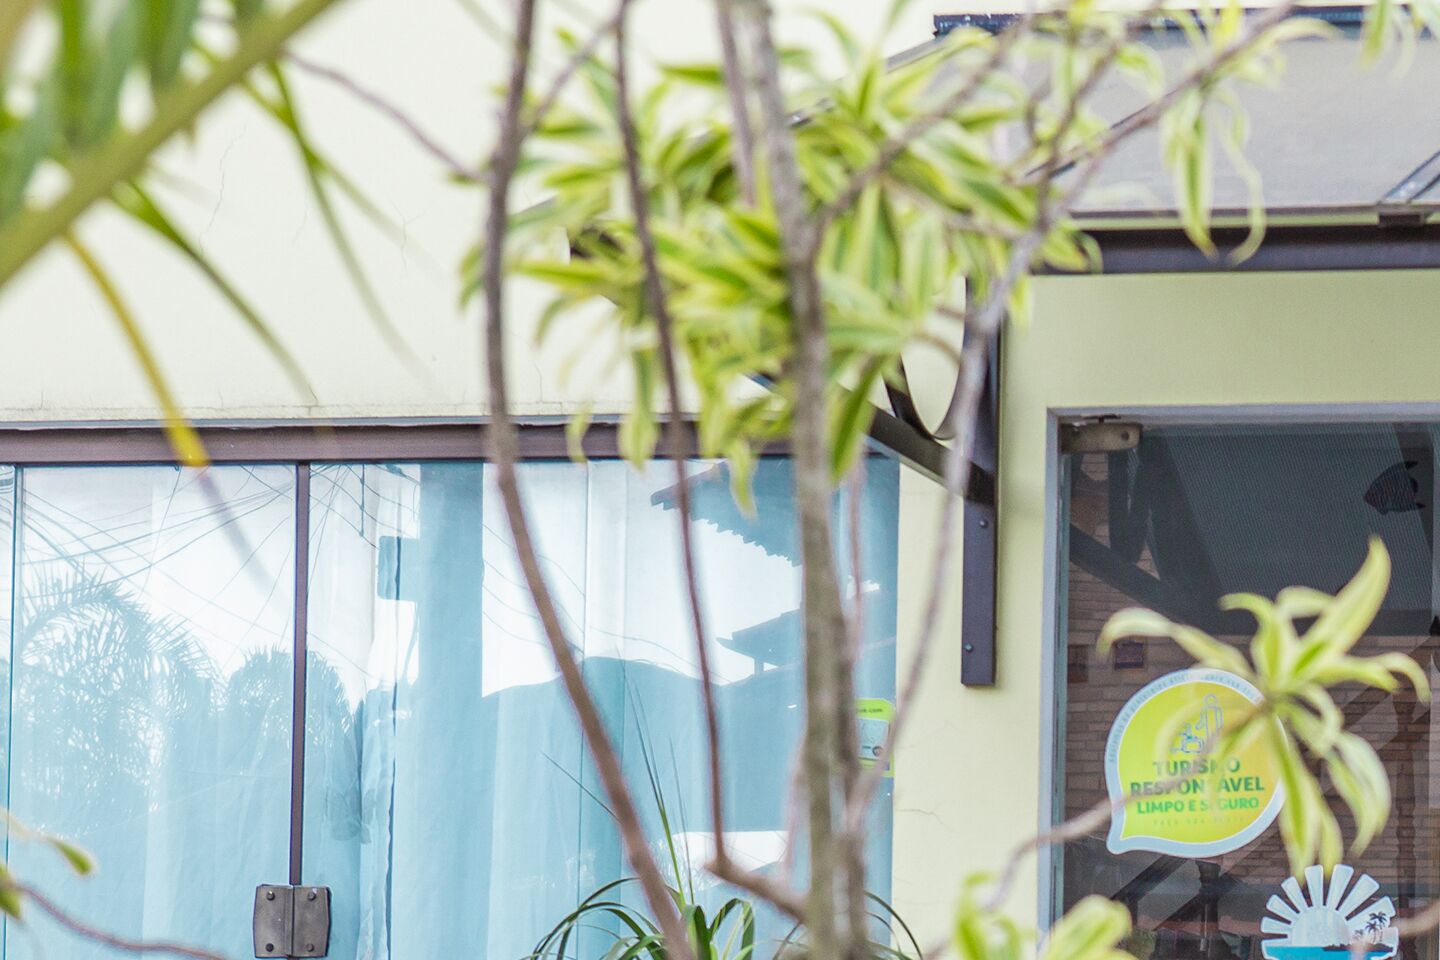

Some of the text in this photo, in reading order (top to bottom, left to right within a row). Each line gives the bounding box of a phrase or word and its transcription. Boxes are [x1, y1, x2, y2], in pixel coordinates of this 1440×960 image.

[1152, 757, 1241, 776] TURISO
[1130, 776, 1265, 796] RESPONÁVEL
[1137, 799, 1184, 814] LIMPO
[1200, 797, 1260, 812] SGURO
